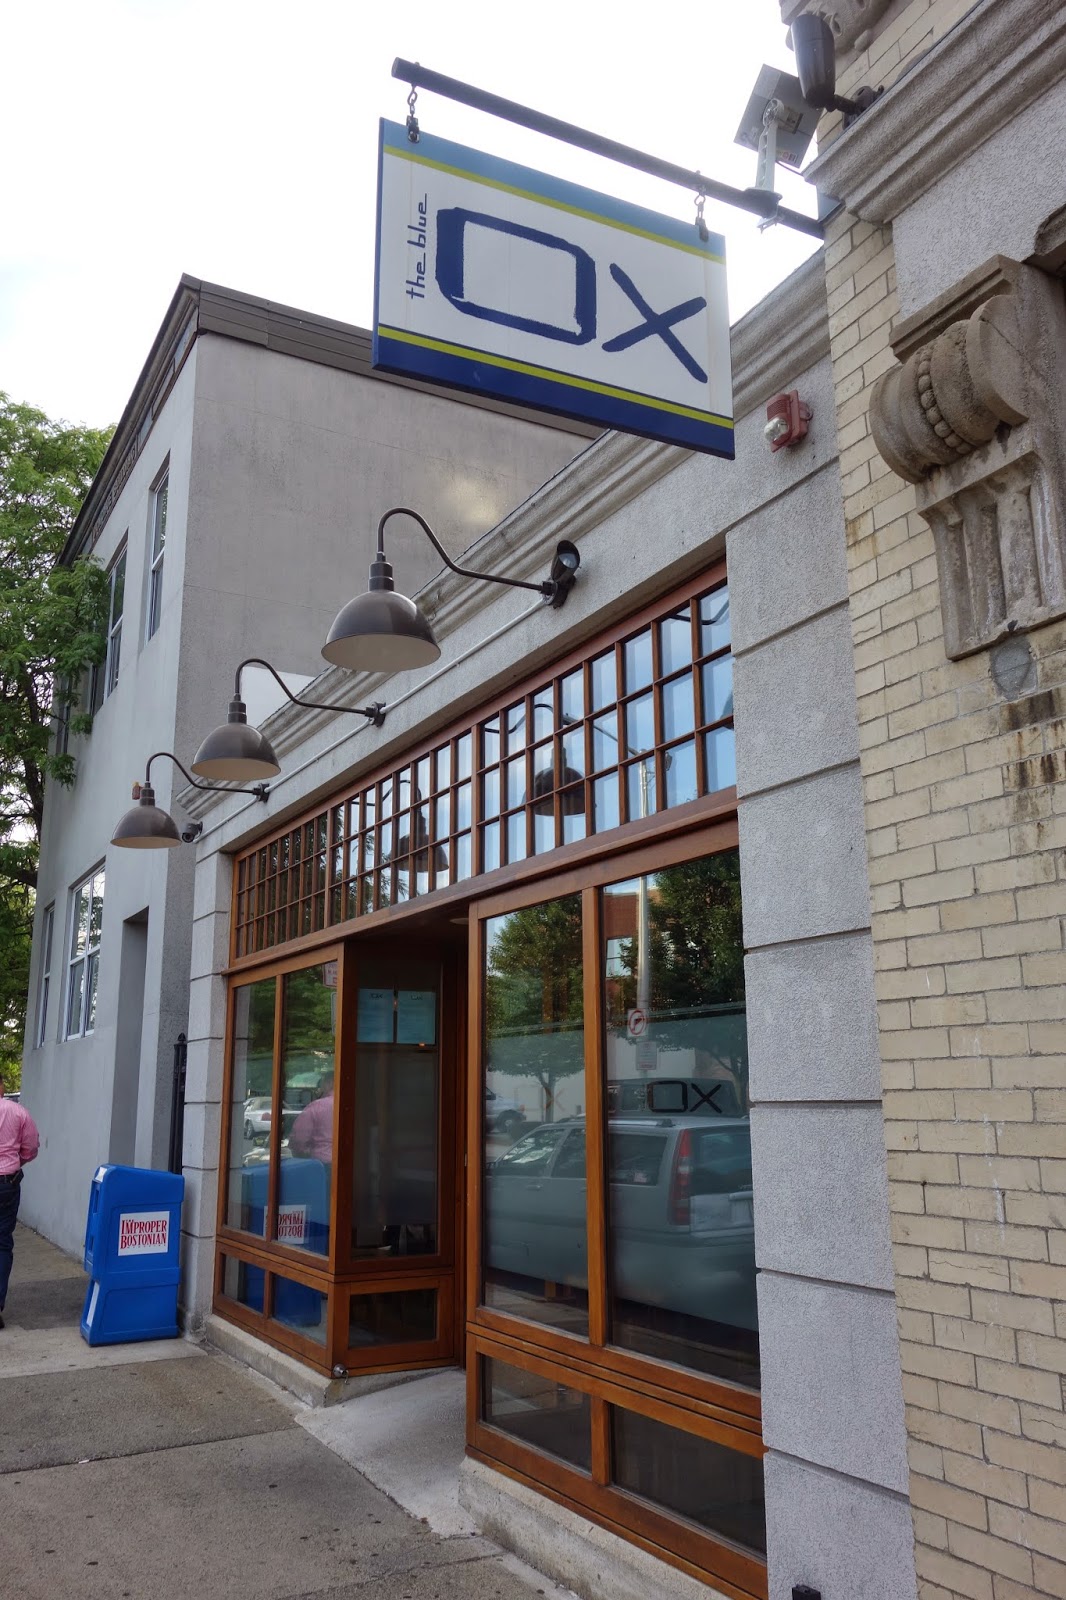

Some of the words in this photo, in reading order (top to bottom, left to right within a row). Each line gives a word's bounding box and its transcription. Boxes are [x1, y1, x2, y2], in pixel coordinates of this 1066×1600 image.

[406, 193, 428, 249] blue
[405, 252, 426, 299] the
[435, 207, 708, 384] OX
[646, 1080, 723, 1114] OX
[120, 1232, 167, 1249] BOSTONIAN
[121, 1219, 168, 1235] IMPROPER
